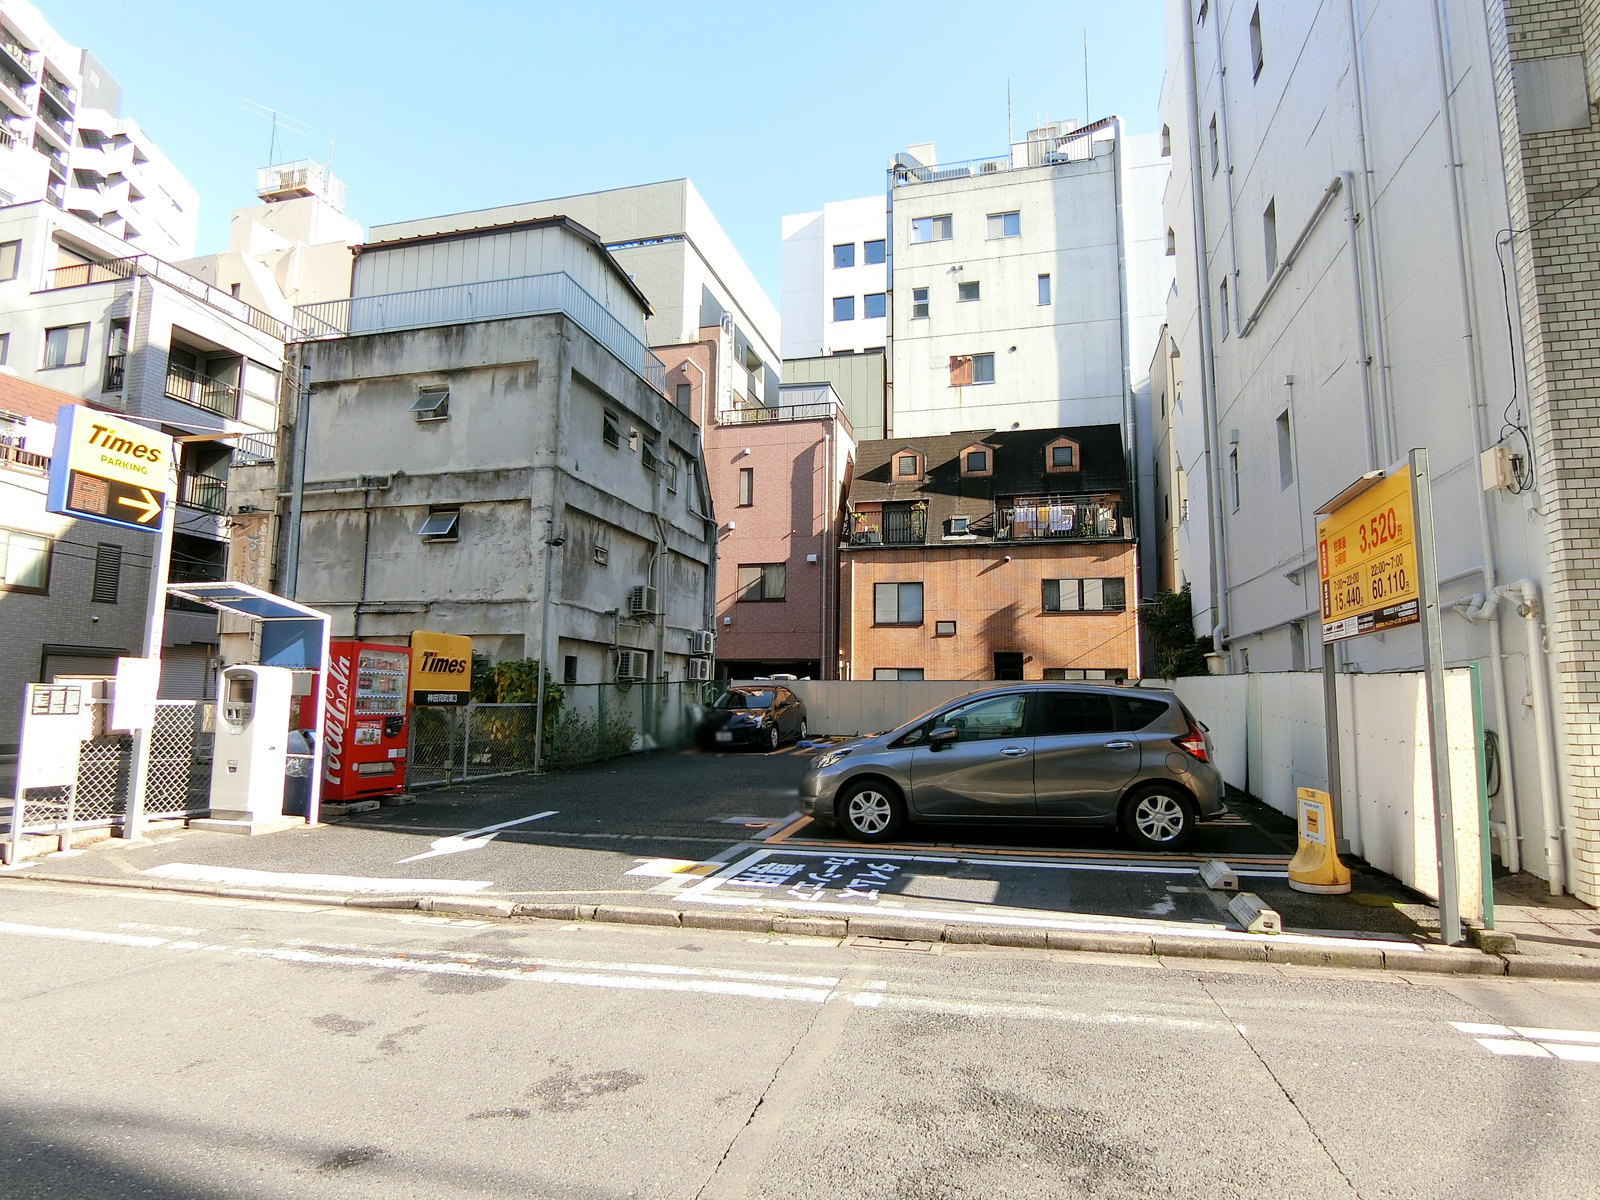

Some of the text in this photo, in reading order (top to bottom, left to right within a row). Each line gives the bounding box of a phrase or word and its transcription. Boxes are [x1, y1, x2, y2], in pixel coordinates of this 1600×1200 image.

[88, 423, 162, 463] Times
[100, 454, 148, 475] PARKING
[420, 651, 467, 674] Times
[726, 862, 807, 889] 専用
[786, 857, 859, 902] カーシェア
[835, 857, 902, 901] タイムズ
